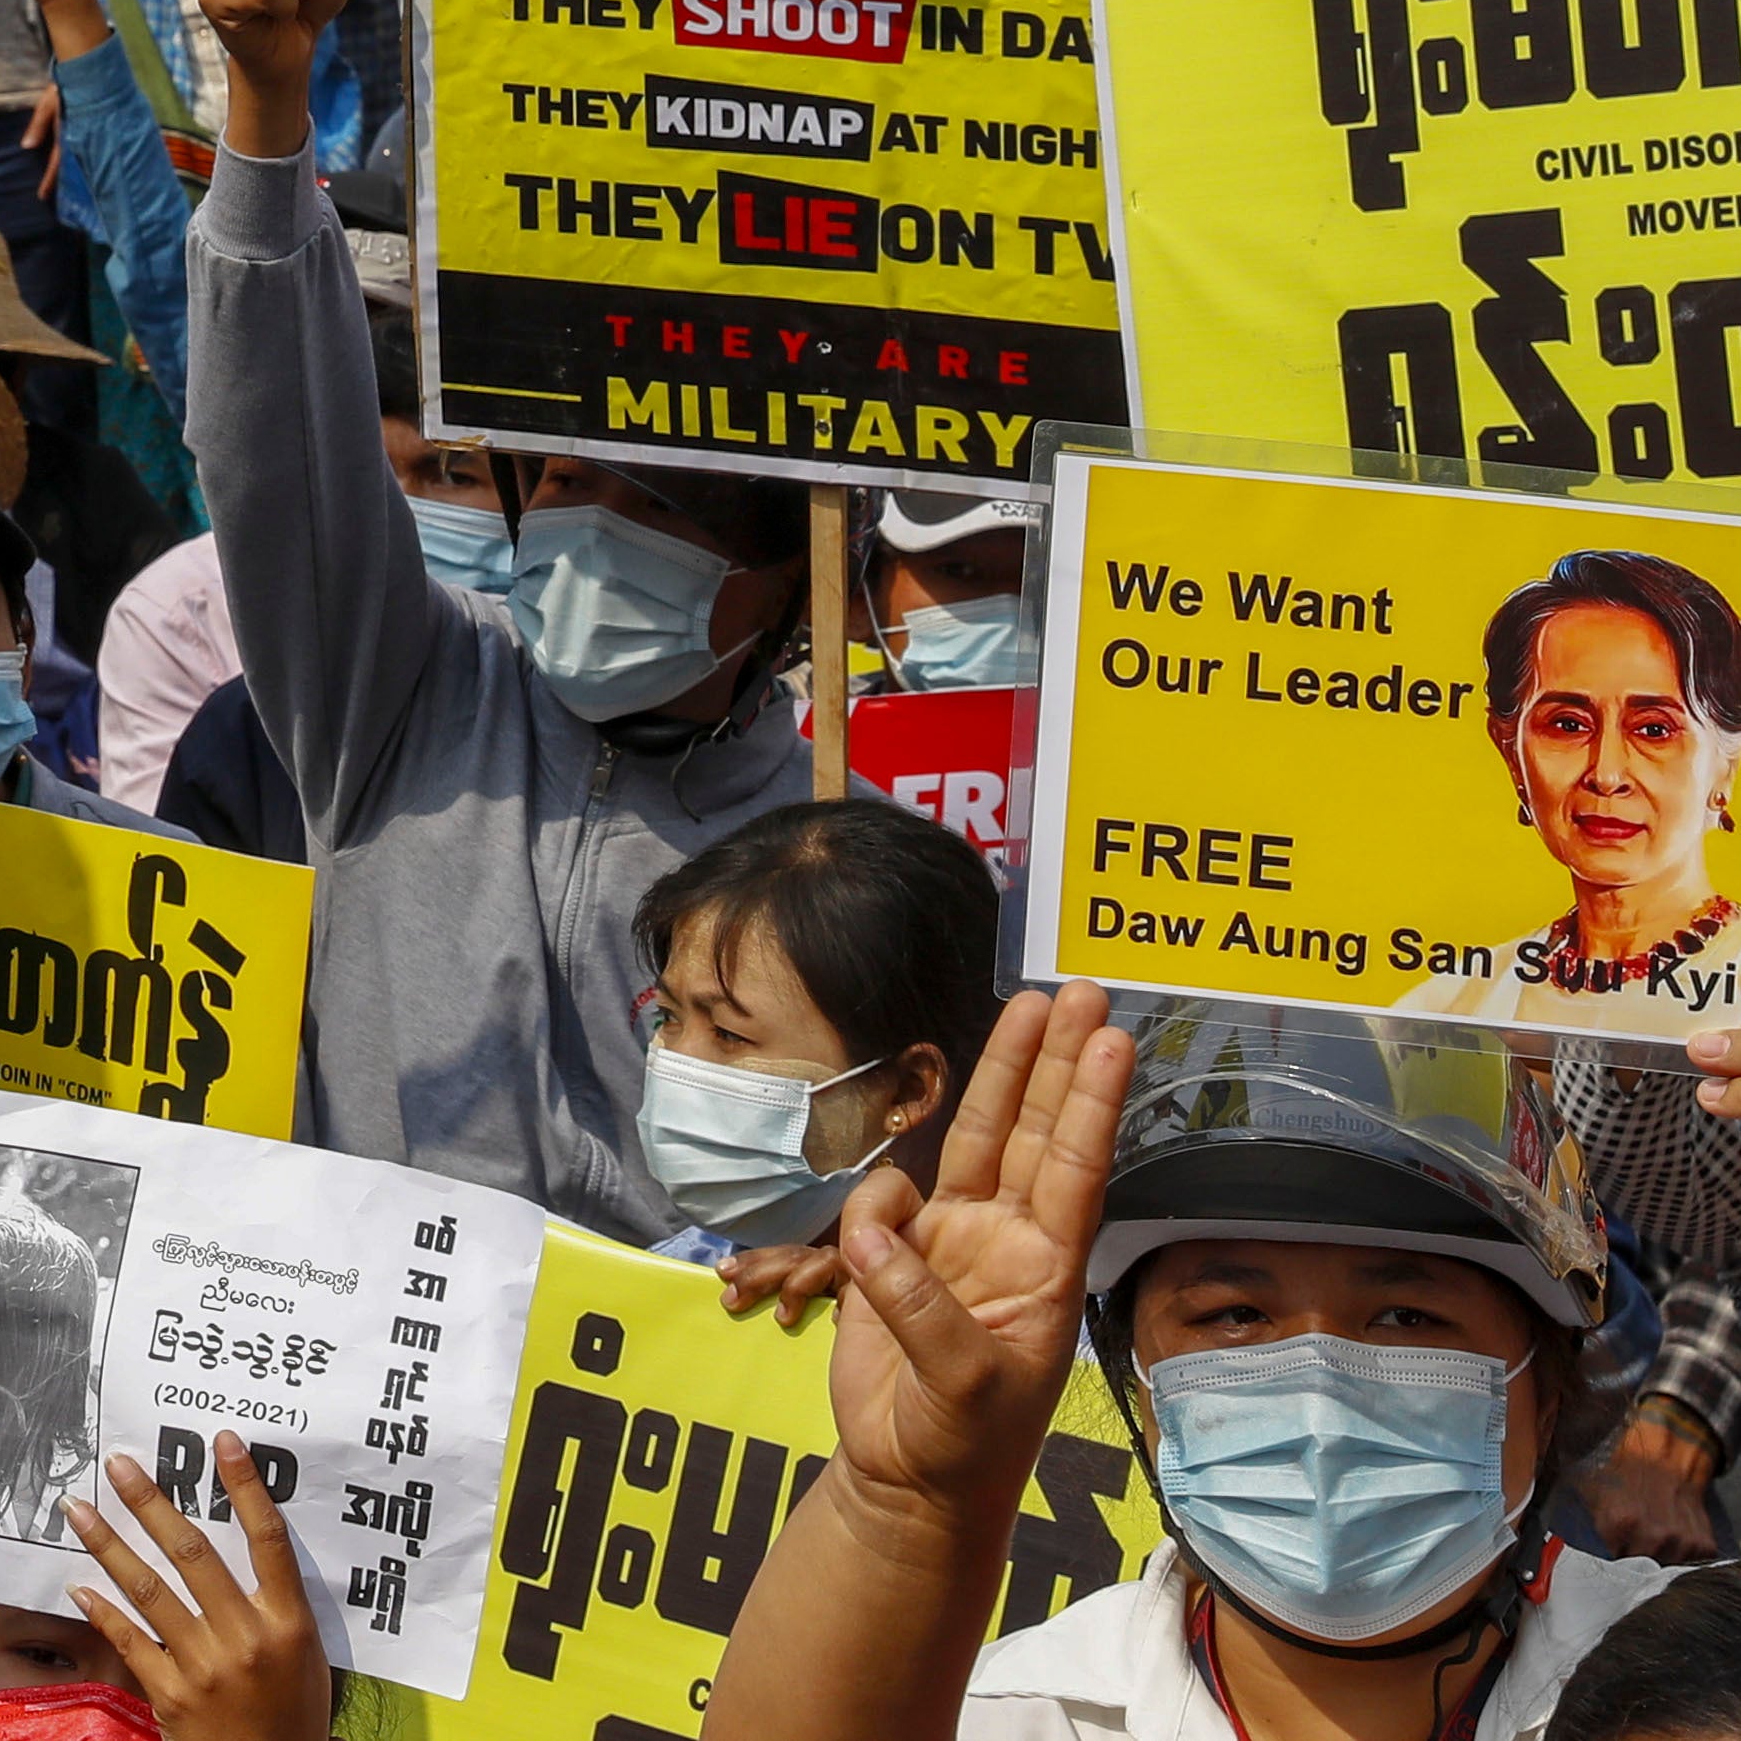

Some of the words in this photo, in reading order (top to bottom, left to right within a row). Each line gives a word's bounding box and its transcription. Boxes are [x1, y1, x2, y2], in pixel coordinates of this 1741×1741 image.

[919, 4, 984, 55] IN
[502, 83, 646, 132] THEY
[654, 96, 864, 149] KIDNAP
[878, 112, 948, 155] AT
[1535, 143, 1633, 182] CIVIL
[504, 172, 717, 243] THEY
[733, 192, 858, 257] LIE
[879, 202, 996, 270] ON
[605, 314, 809, 364] THEY
[875, 337, 1030, 386] ARE
[606, 375, 1034, 468] MILITARY
[1106, 560, 1204, 614] We
[1227, 571, 1395, 635] Want
[1100, 638, 1222, 696] Our
[1245, 651, 1475, 721] Leader
[1093, 817, 1295, 893] FREE
[1086, 895, 1208, 949] Daw
[1218, 908, 1368, 977] Aung
[1387, 928, 1495, 981] San
[1513, 941, 1625, 995] Suu
[1646, 952, 1737, 1014] Kyi
[35, 1068, 54, 1092] IN
[1253, 1107, 1375, 1135] Chengshuo
[153, 1382, 309, 1433] (2002-2021)
